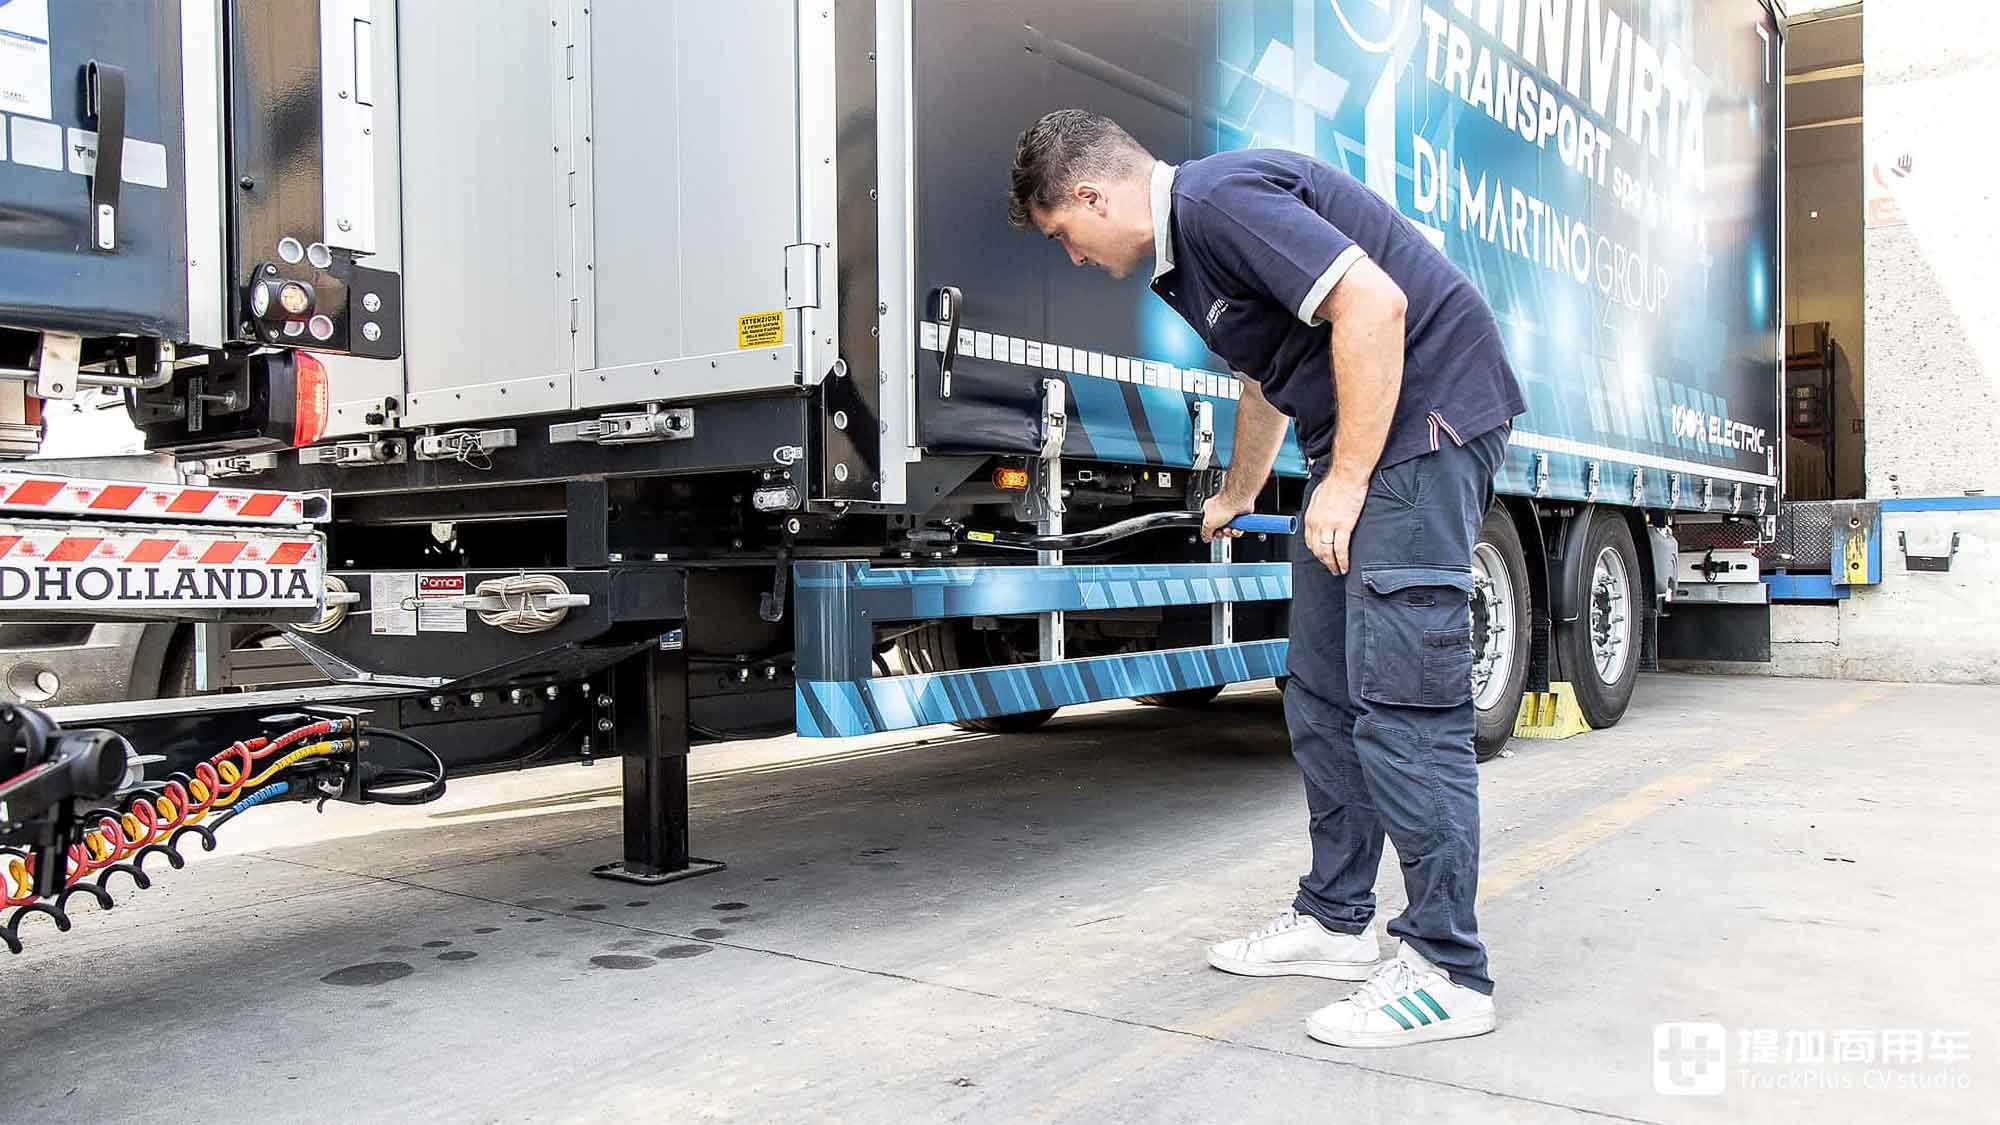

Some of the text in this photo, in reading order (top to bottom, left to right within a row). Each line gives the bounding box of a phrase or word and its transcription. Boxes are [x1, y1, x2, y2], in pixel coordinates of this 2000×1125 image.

[1422, 6, 1612, 187] TRANSPORT
[1413, 132, 1448, 222] DI
[1458, 156, 1591, 285] MARTINO
[1595, 235, 1669, 321] GROUP
[1709, 415, 1766, 454] ELECTRIC
[0, 567, 313, 600] DHOLLANDIA
